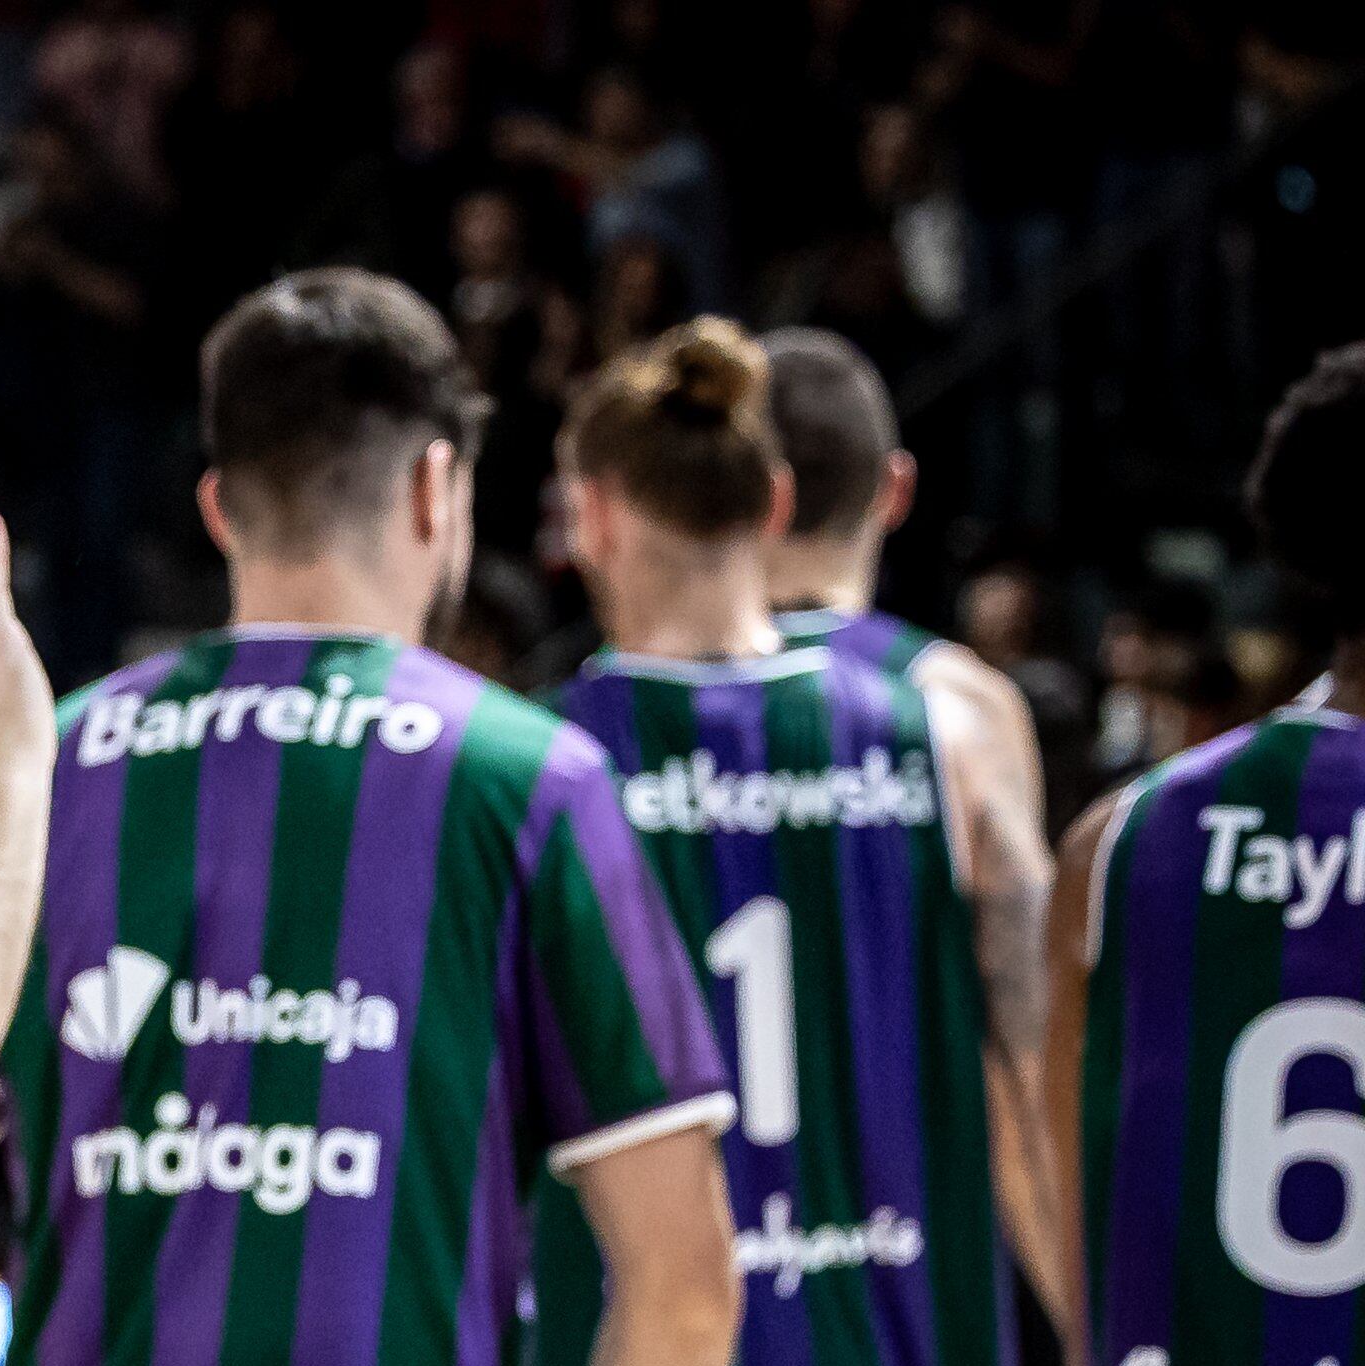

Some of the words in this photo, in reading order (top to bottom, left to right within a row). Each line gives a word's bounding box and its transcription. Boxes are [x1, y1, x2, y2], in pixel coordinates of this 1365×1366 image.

[78, 673, 443, 768] Barreiro
[623, 746, 934, 834] etkowski
[172, 974, 400, 1064] Unicaja
[704, 895, 800, 1147] 1
[1217, 997, 1365, 1297] 6
